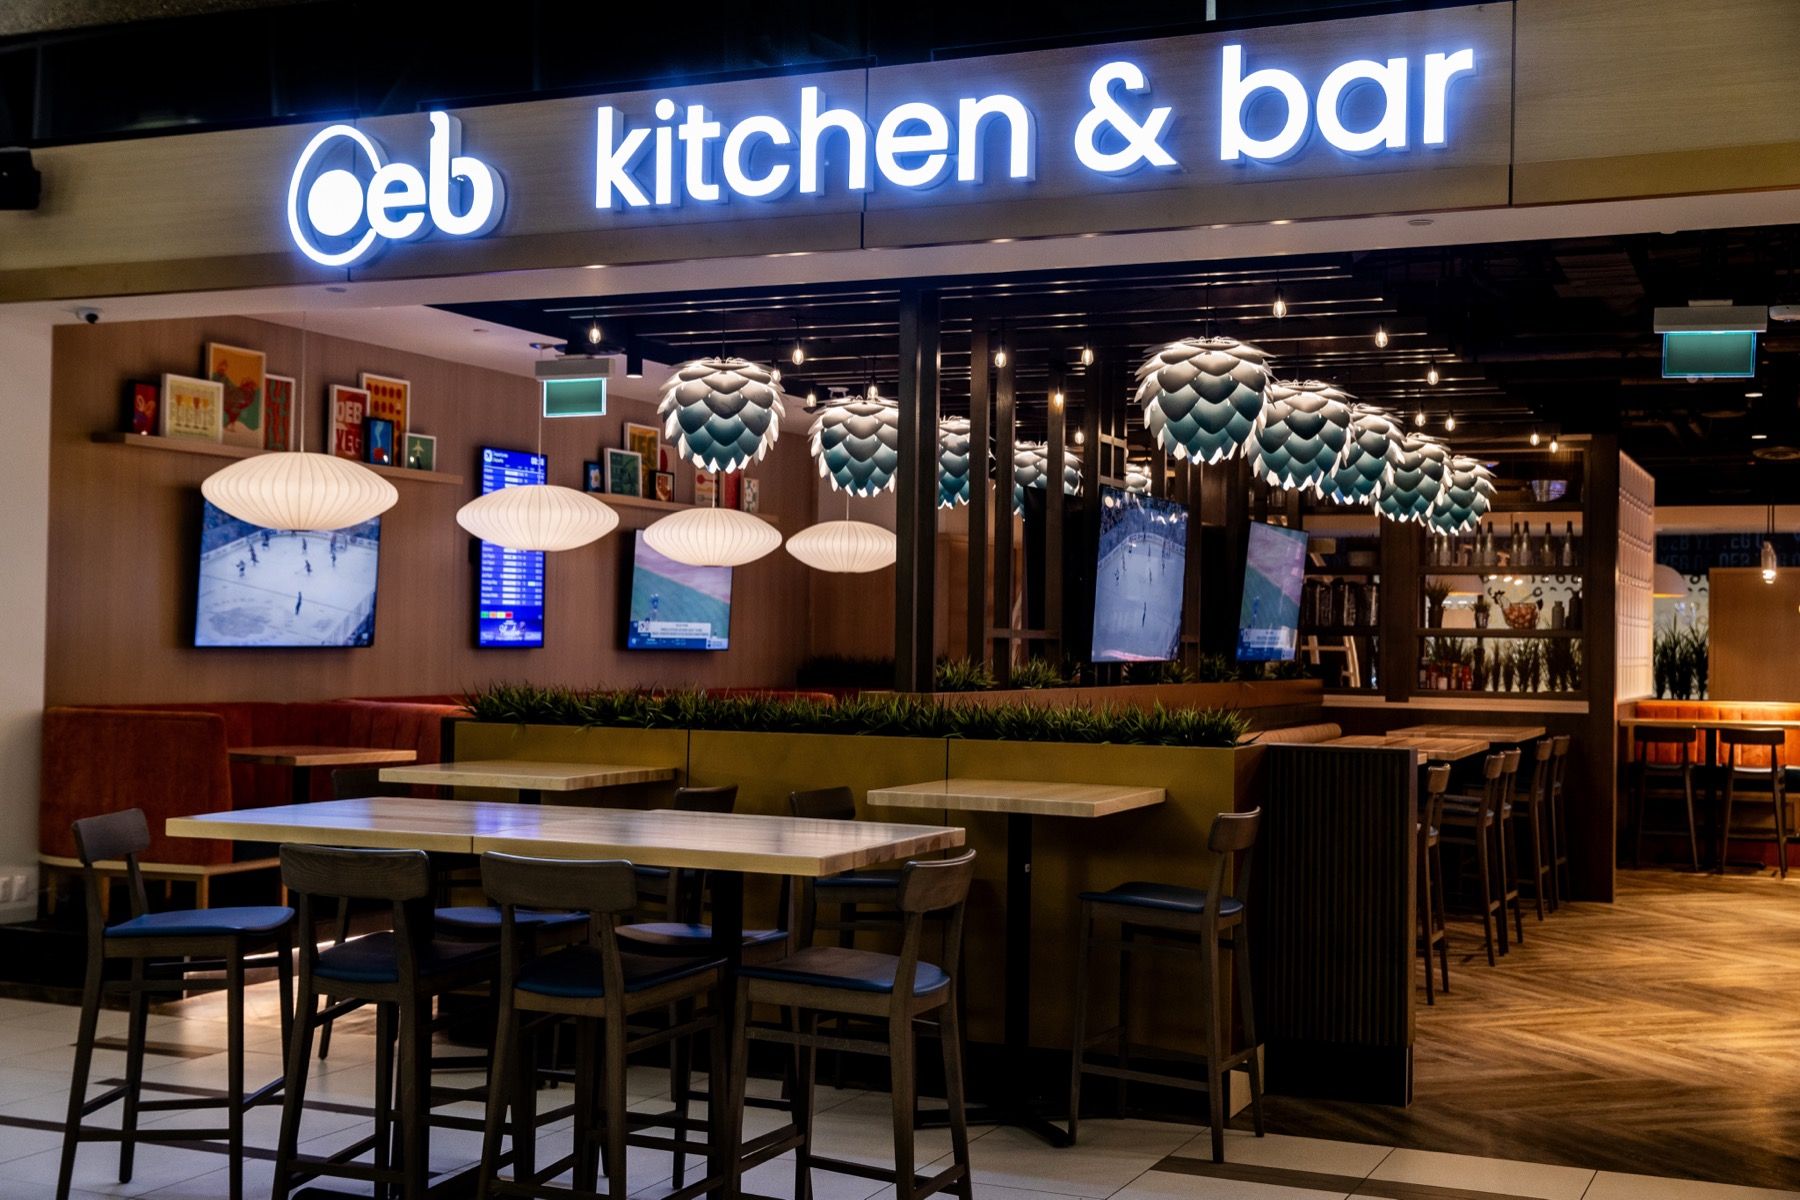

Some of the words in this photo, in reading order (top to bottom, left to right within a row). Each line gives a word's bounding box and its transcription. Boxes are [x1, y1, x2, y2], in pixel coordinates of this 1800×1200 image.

[595, 86, 1030, 208] kitchen
[1074, 61, 1178, 173] &
[1221, 44, 1474, 161] bar
